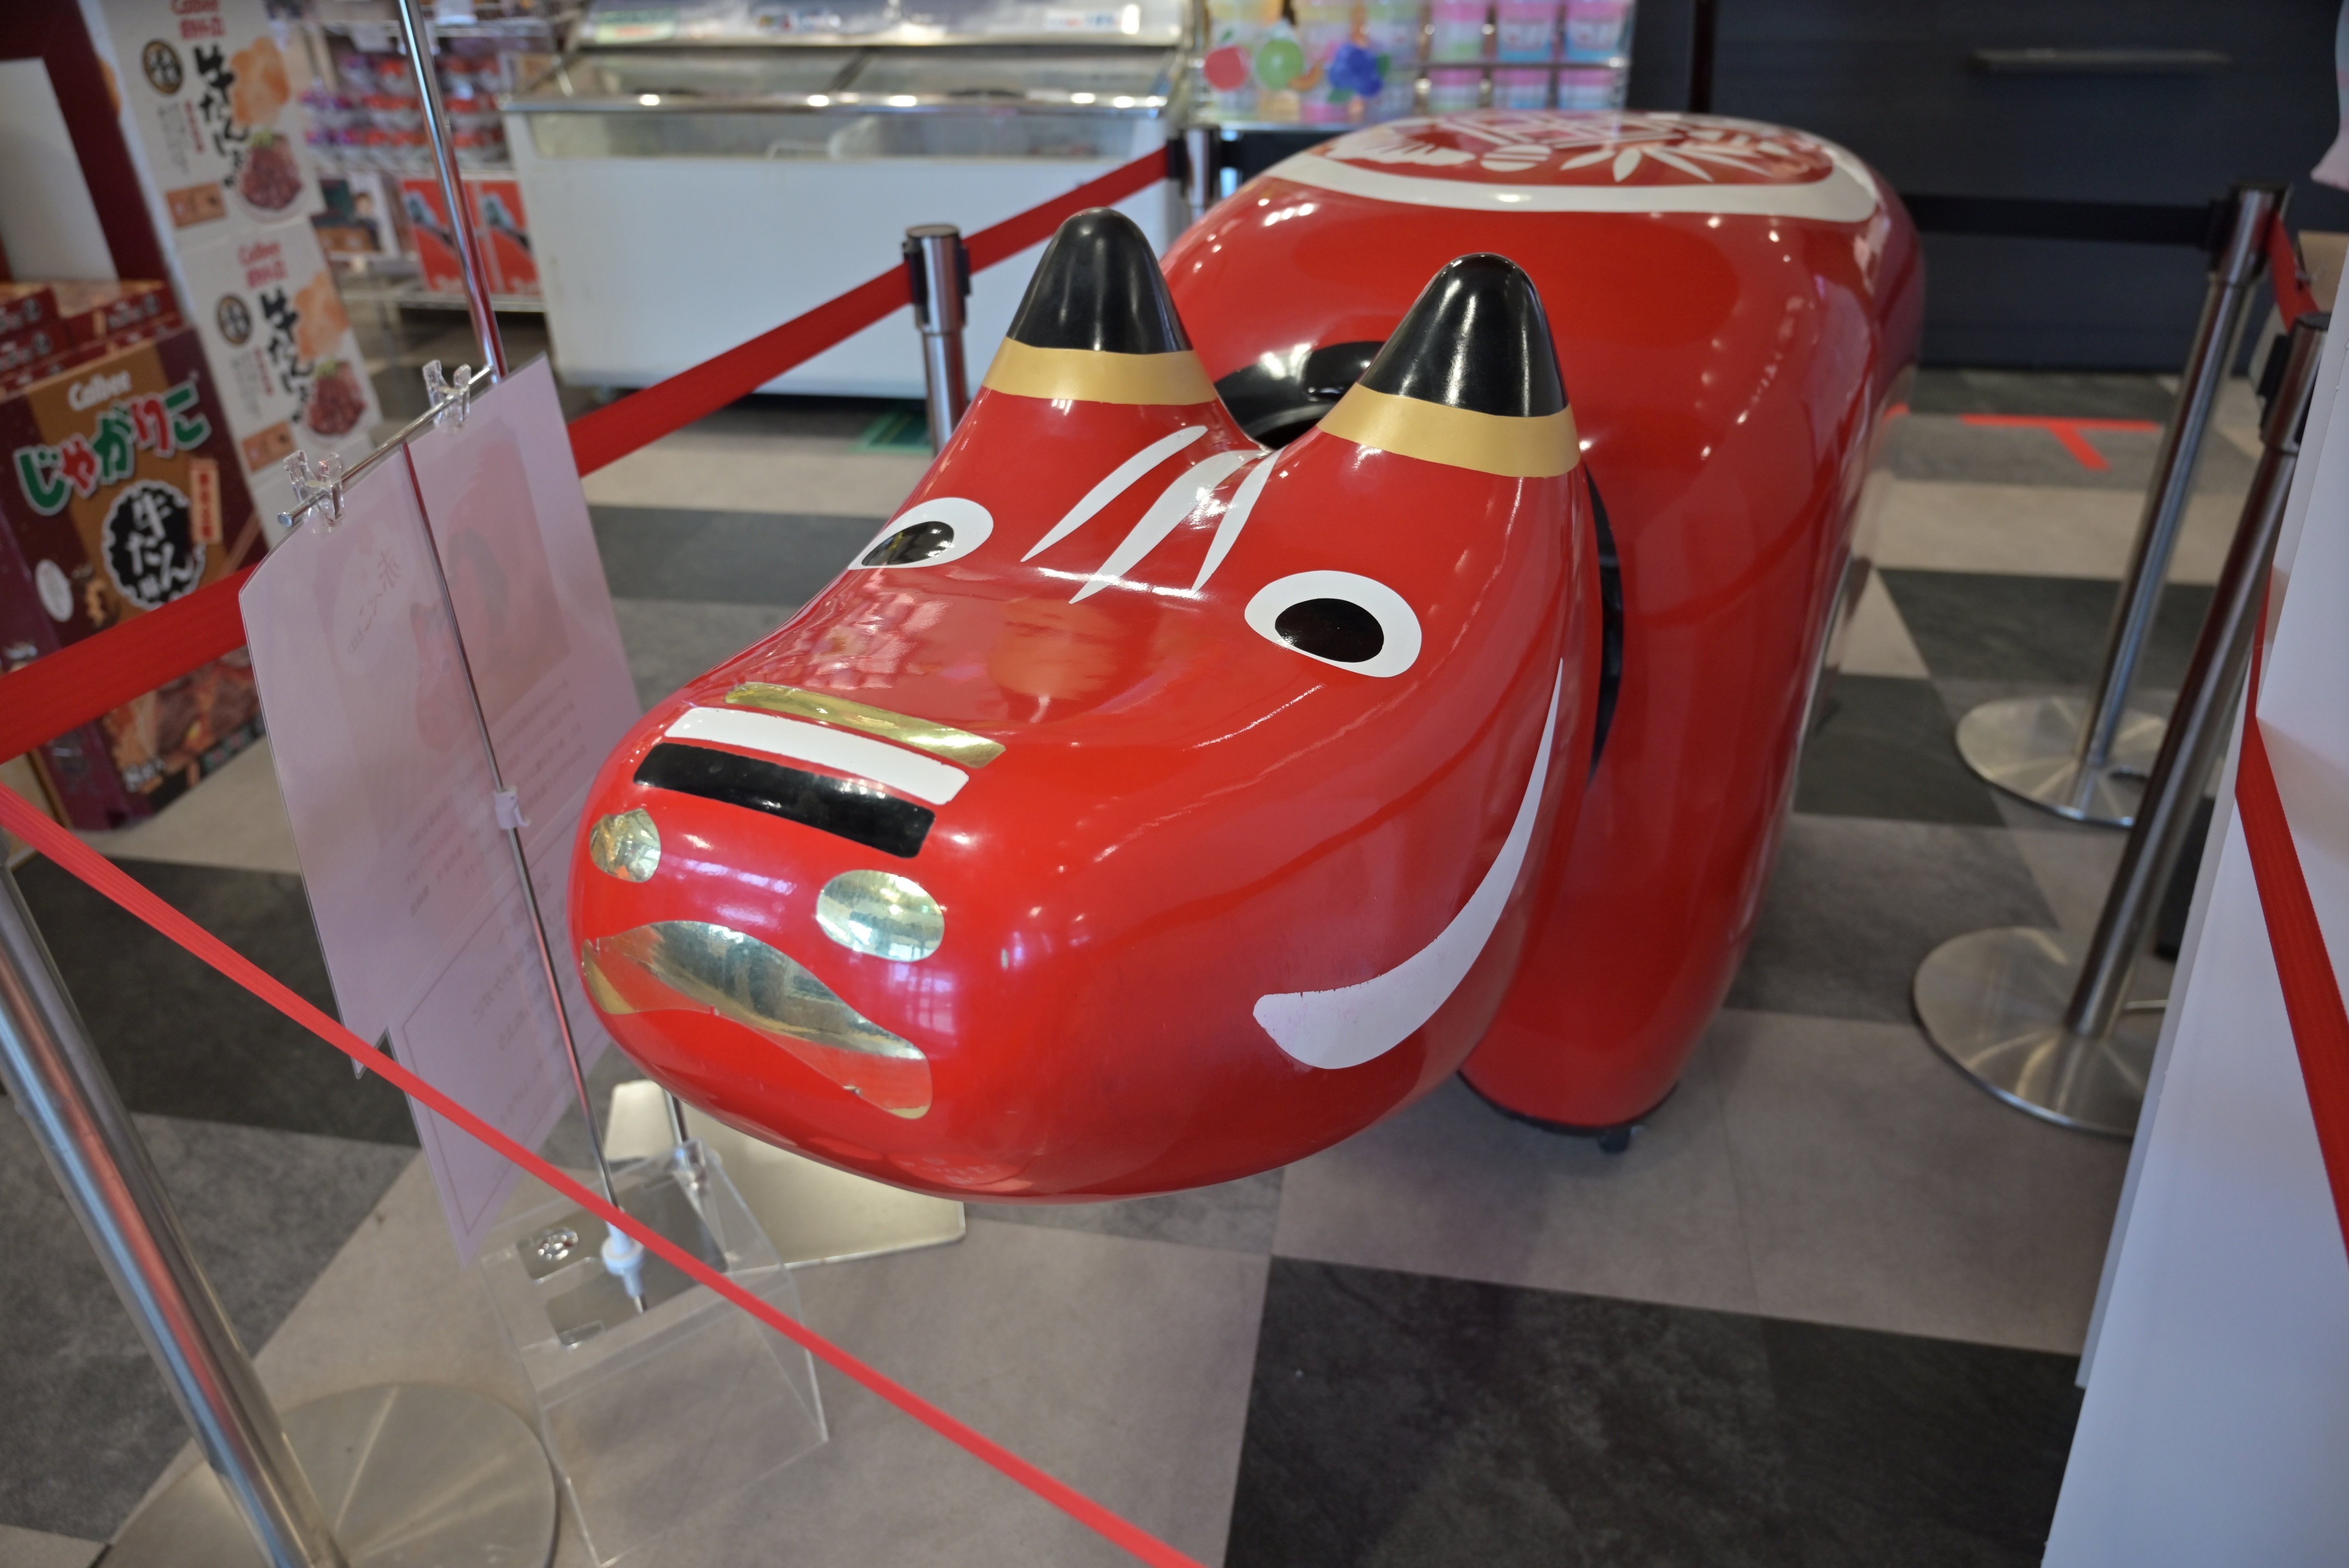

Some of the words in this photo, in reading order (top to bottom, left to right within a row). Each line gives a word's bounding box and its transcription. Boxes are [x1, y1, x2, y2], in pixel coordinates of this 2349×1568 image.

[68, 370, 132, 412] Calbee
[12, 379, 212, 516] じゃがりこ
